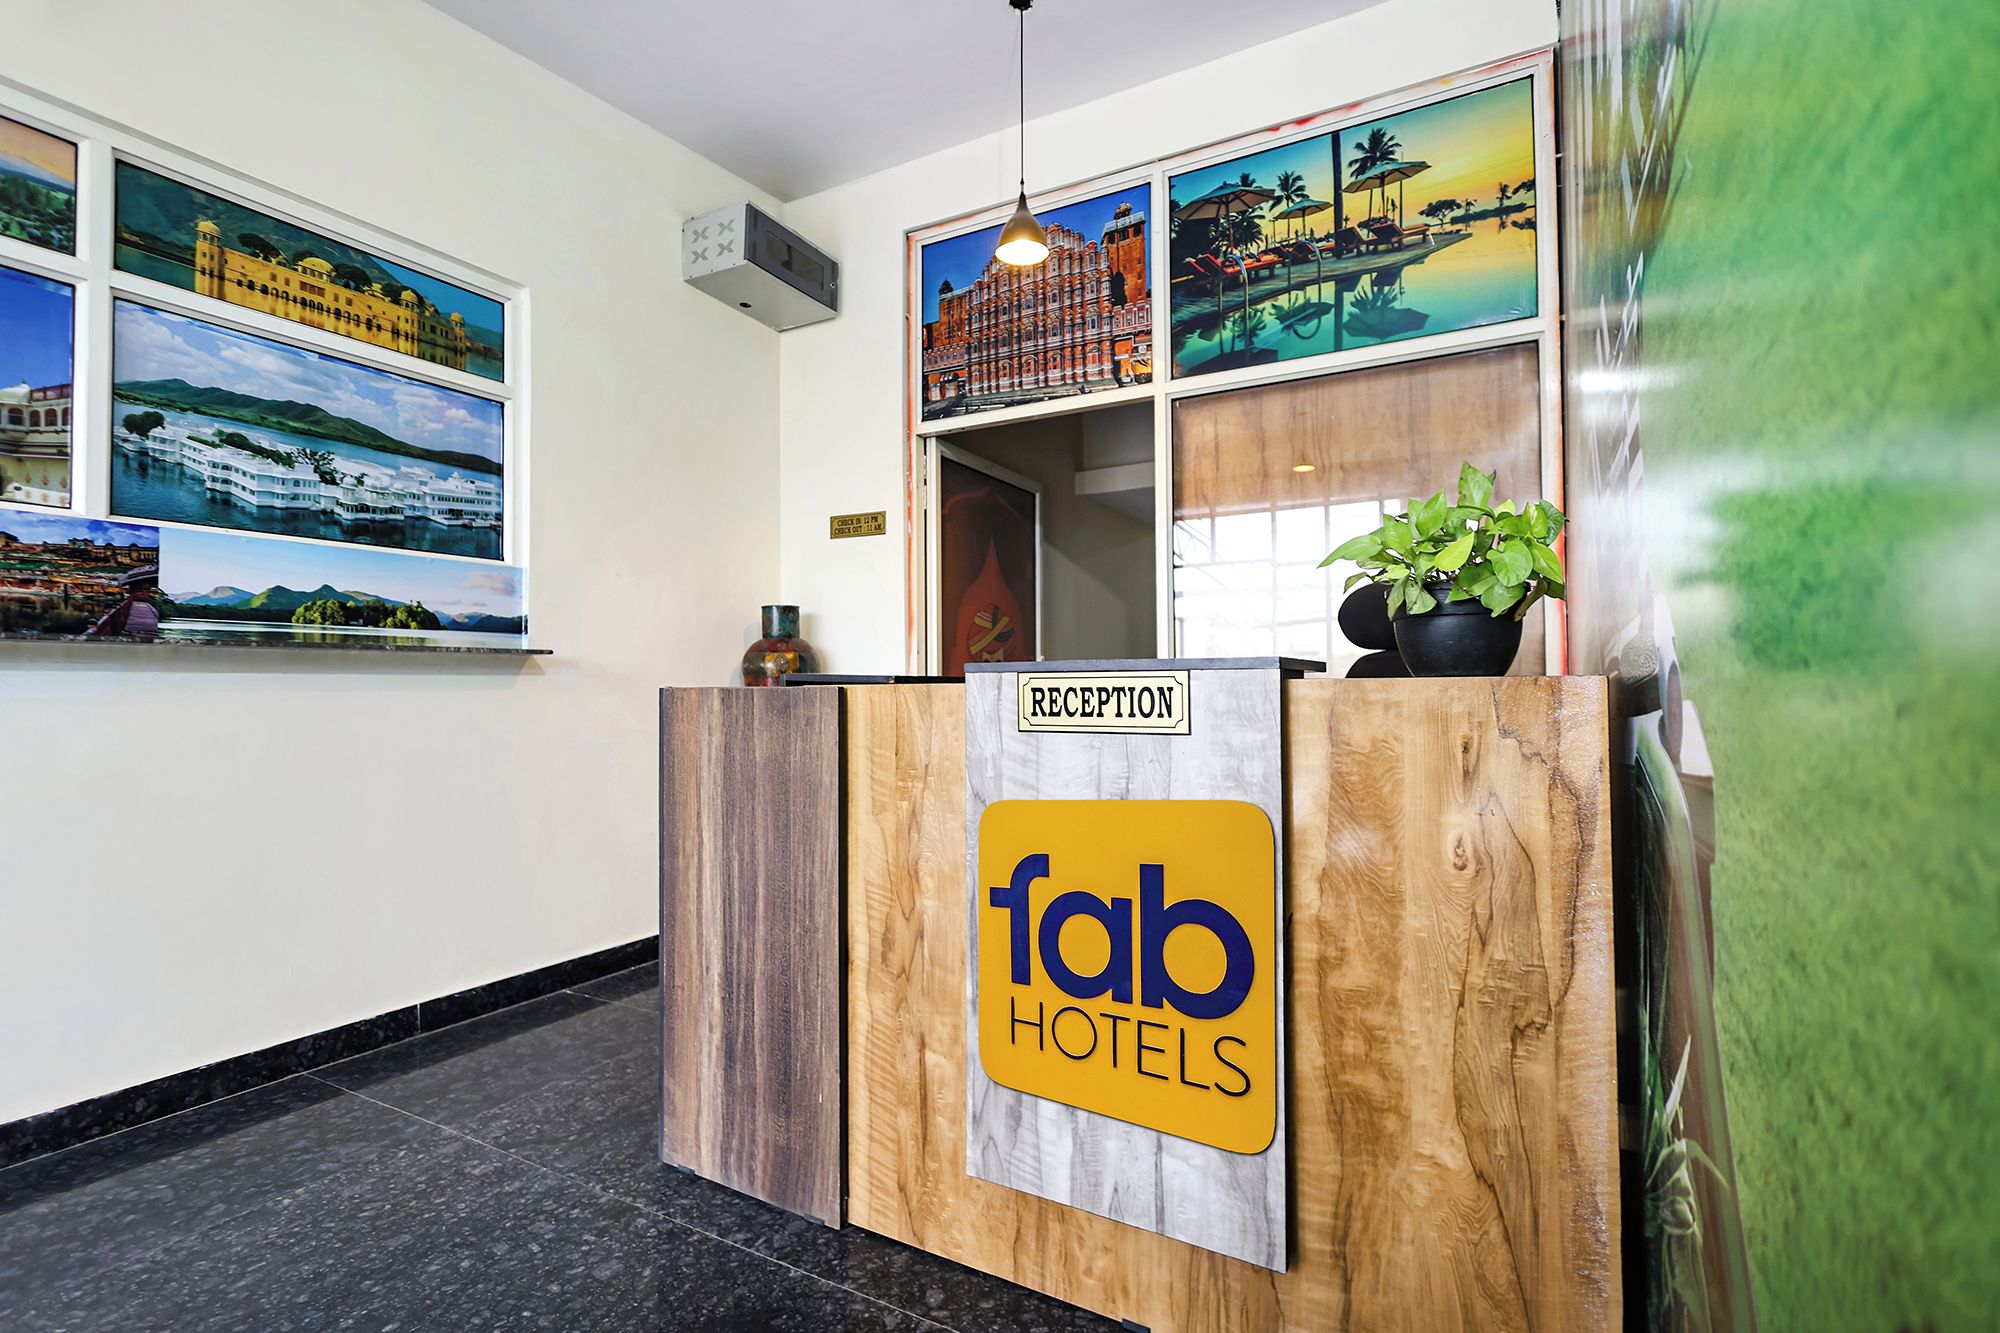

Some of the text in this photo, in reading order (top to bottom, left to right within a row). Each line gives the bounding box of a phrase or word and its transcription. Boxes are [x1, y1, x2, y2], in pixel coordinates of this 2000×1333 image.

[834, 526, 851, 535] CHECK
[867, 524, 873, 532] 11
[874, 523, 882, 531] AM
[837, 518, 854, 527] CHECK
[863, 516, 870, 524] 12
[871, 515, 879, 523] PM
[1030, 686, 1174, 718] RECEPTION
[989, 853, 1255, 1020] fab
[1010, 996, 1251, 1097] HOTELS
